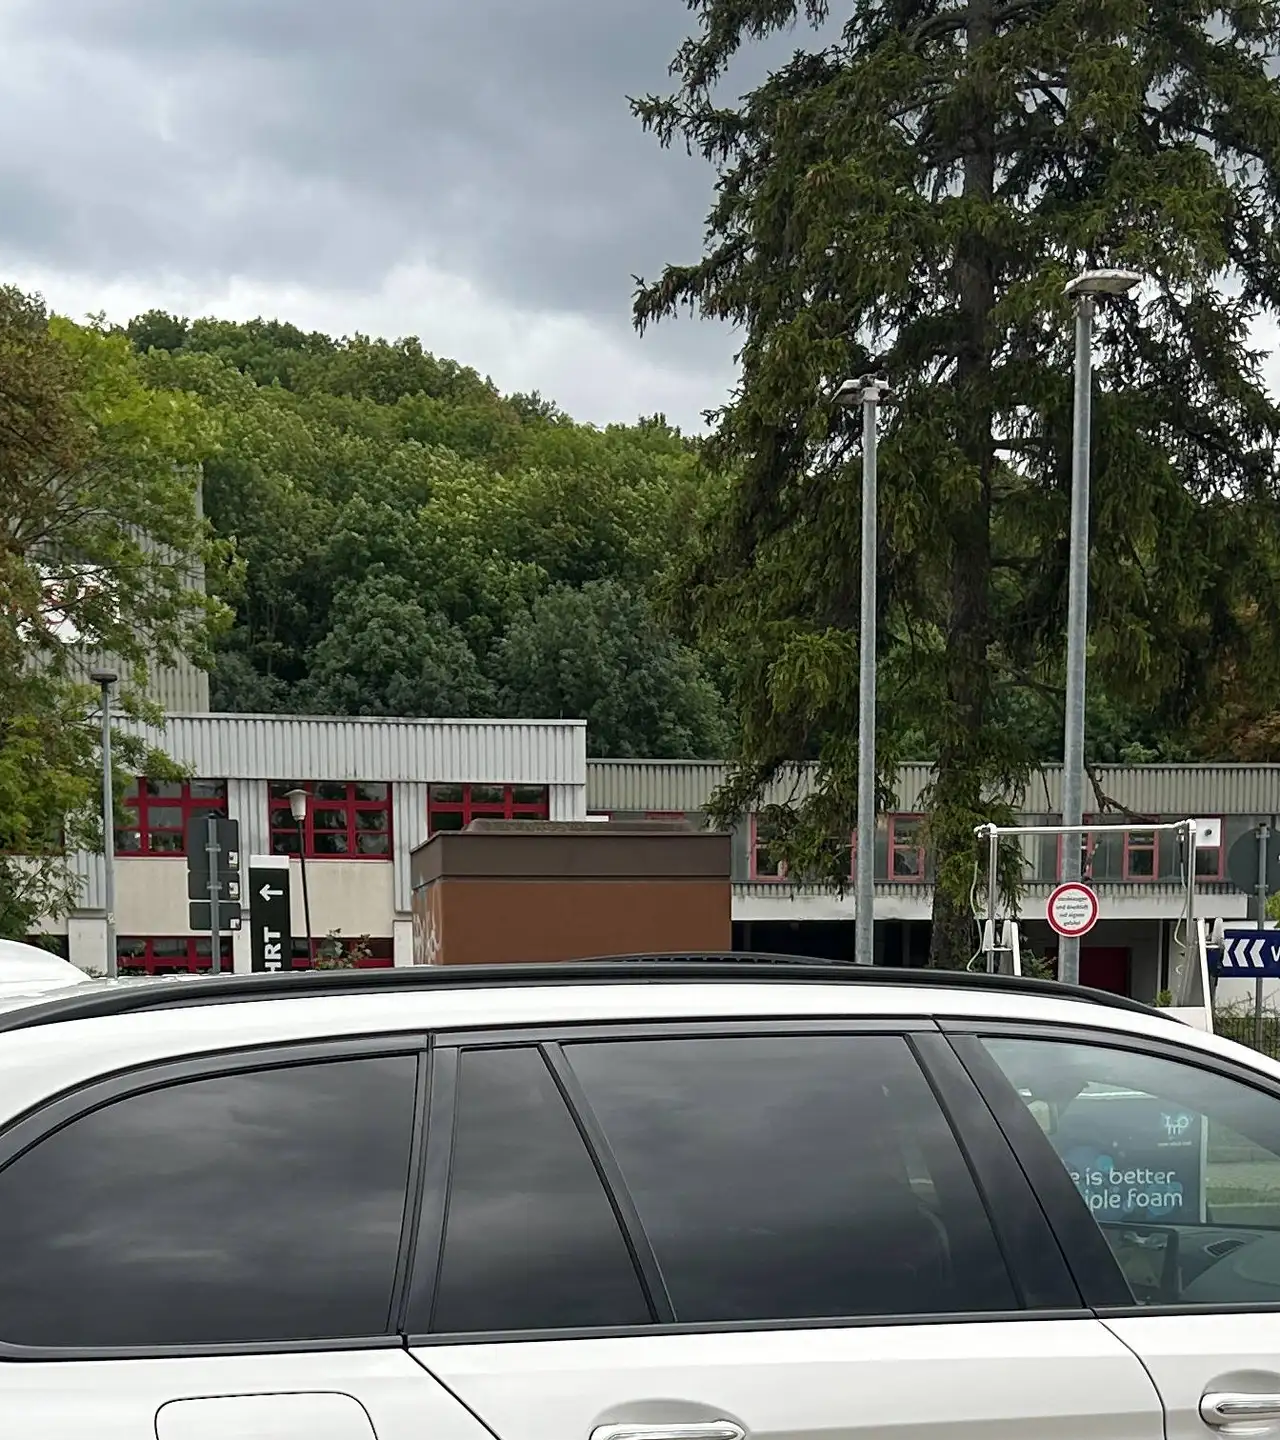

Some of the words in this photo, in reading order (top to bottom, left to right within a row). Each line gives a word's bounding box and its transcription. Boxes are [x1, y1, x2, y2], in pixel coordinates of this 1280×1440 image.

[263, 926, 282, 972] HRT
[1085, 1168, 1103, 1185] is
[1109, 1168, 1176, 1185] better
[1084, 1189, 1121, 1212] iple
[1127, 1188, 1184, 1208] foam
